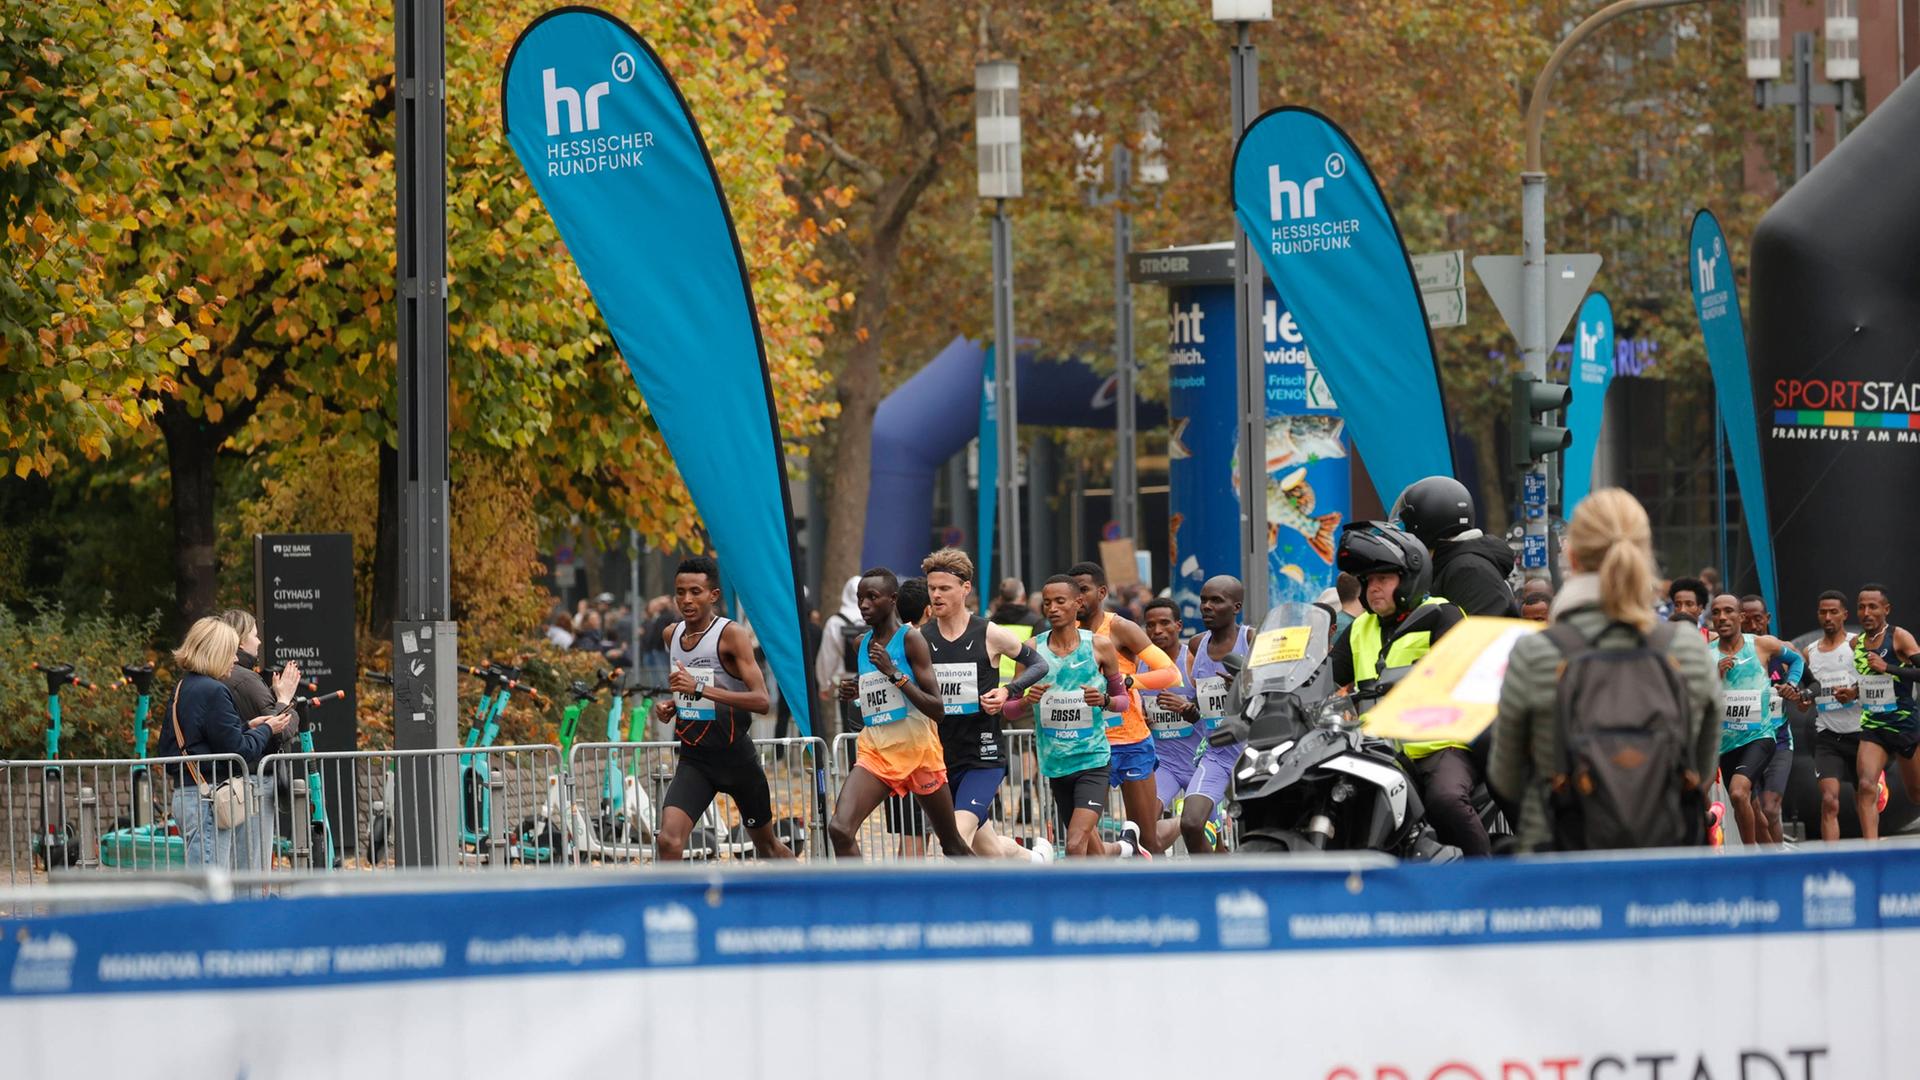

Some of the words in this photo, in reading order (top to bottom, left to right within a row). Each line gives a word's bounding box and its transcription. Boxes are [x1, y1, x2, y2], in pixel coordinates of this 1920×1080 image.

[543, 67, 609, 136] hr
[547, 131, 654, 159] HESSISCHER
[548, 151, 644, 177] RUNDFUNK
[1268, 164, 1324, 221] hr
[1271, 219, 1360, 240] HESSISCHER
[1271, 235, 1352, 255] RUNDFUNK
[1139, 256, 1189, 273] STRÖER
[1698, 248, 1716, 293] hr
[1581, 321, 1598, 361] hr
[1772, 427, 1860, 441] FRANKFURT
[1866, 430, 1890, 442] AM
[292, 545, 311, 553] BANK
[273, 589, 313, 600] CITYHAUS
[314, 589, 321, 599] II
[275, 647, 315, 658] CITYHAUS
[316, 648, 319, 657] I
[937, 669, 972, 677] mainova
[866, 689, 888, 708] PACE
[680, 710, 700, 719] HOKA
[944, 704, 964, 714] OKA
[1050, 709, 1081, 722] GOSSA
[1725, 705, 1752, 717] ABAY
[871, 712, 892, 725] HOKA
[1055, 730, 1079, 739] HOKA
[1159, 730, 1180, 738] HOKA
[1390, 781, 1406, 798] GS
[1625, 898, 1780, 928] #runtheskyline
